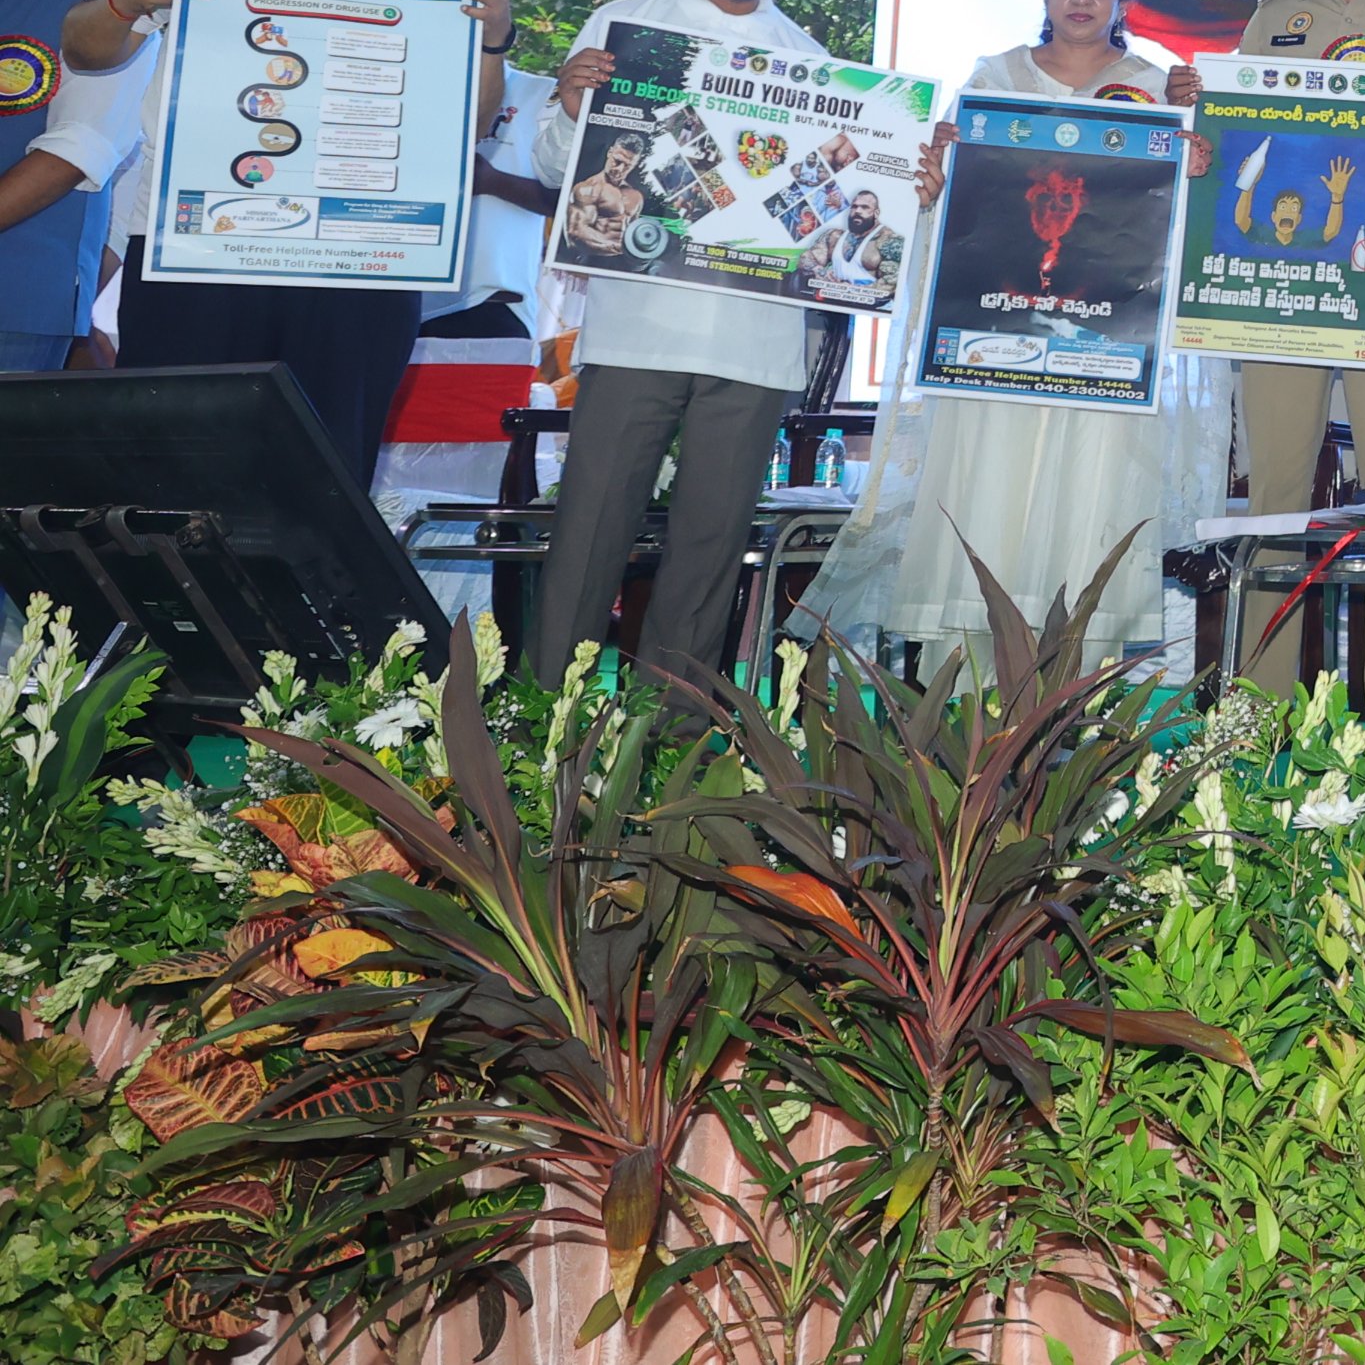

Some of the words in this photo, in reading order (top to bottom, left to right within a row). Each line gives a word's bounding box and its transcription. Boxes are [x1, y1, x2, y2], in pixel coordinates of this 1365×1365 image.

[335, 3, 362, 14] DRUG
[365, 7, 379, 15] USE
[610, 77, 632, 94] TO
[635, 81, 701, 106] BECOME
[705, 96, 790, 124] STRONGER
[701, 72, 753, 98] BUILD
[761, 85, 809, 110] YOUR
[813, 93, 864, 121] BODY
[605, 105, 642, 119] NATURAL
[1204, 104, 1257, 118] తెలంగాణ
[1260, 105, 1303, 122] యాంటీ
[795, 115, 815, 126] BUT,
[817, 118, 828, 128] IN
[831, 120, 839, 130] A
[841, 123, 870, 136] RIGHT
[872, 130, 893, 141] WAY
[869, 153, 909, 167] ARTIFICIAL
[878, 167, 915, 179] BUILDING
[223, 244, 273, 254] Toll-Free
[276, 245, 321, 257] Helpline
[686, 244, 705, 254] DAIL
[728, 250, 736, 259] TO
[739, 251, 759, 262] SAVE
[761, 254, 789, 266] YOUTH
[239, 257, 280, 267] TGANB
[283, 259, 305, 268] Toll
[307, 260, 332, 269] Free
[335, 261, 351, 270] No
[360, 262, 387, 271] 1908
[685, 258, 707, 269] FROM
[709, 261, 747, 275] STEROIDS
[1260, 259, 1311, 287] ఇస్తుంది
[1062, 299, 1113, 318] చెప్పండి
[941, 366, 991, 378] Toll-Free
[994, 371, 1040, 383] Helpline
[1044, 375, 1086, 385] Number
[1098, 380, 1132, 389] 14446
[925, 375, 951, 385] Help
[954, 377, 981, 387] Desk
[985, 379, 1031, 391] Number:
[1035, 383, 1144, 399] 040-23004002
